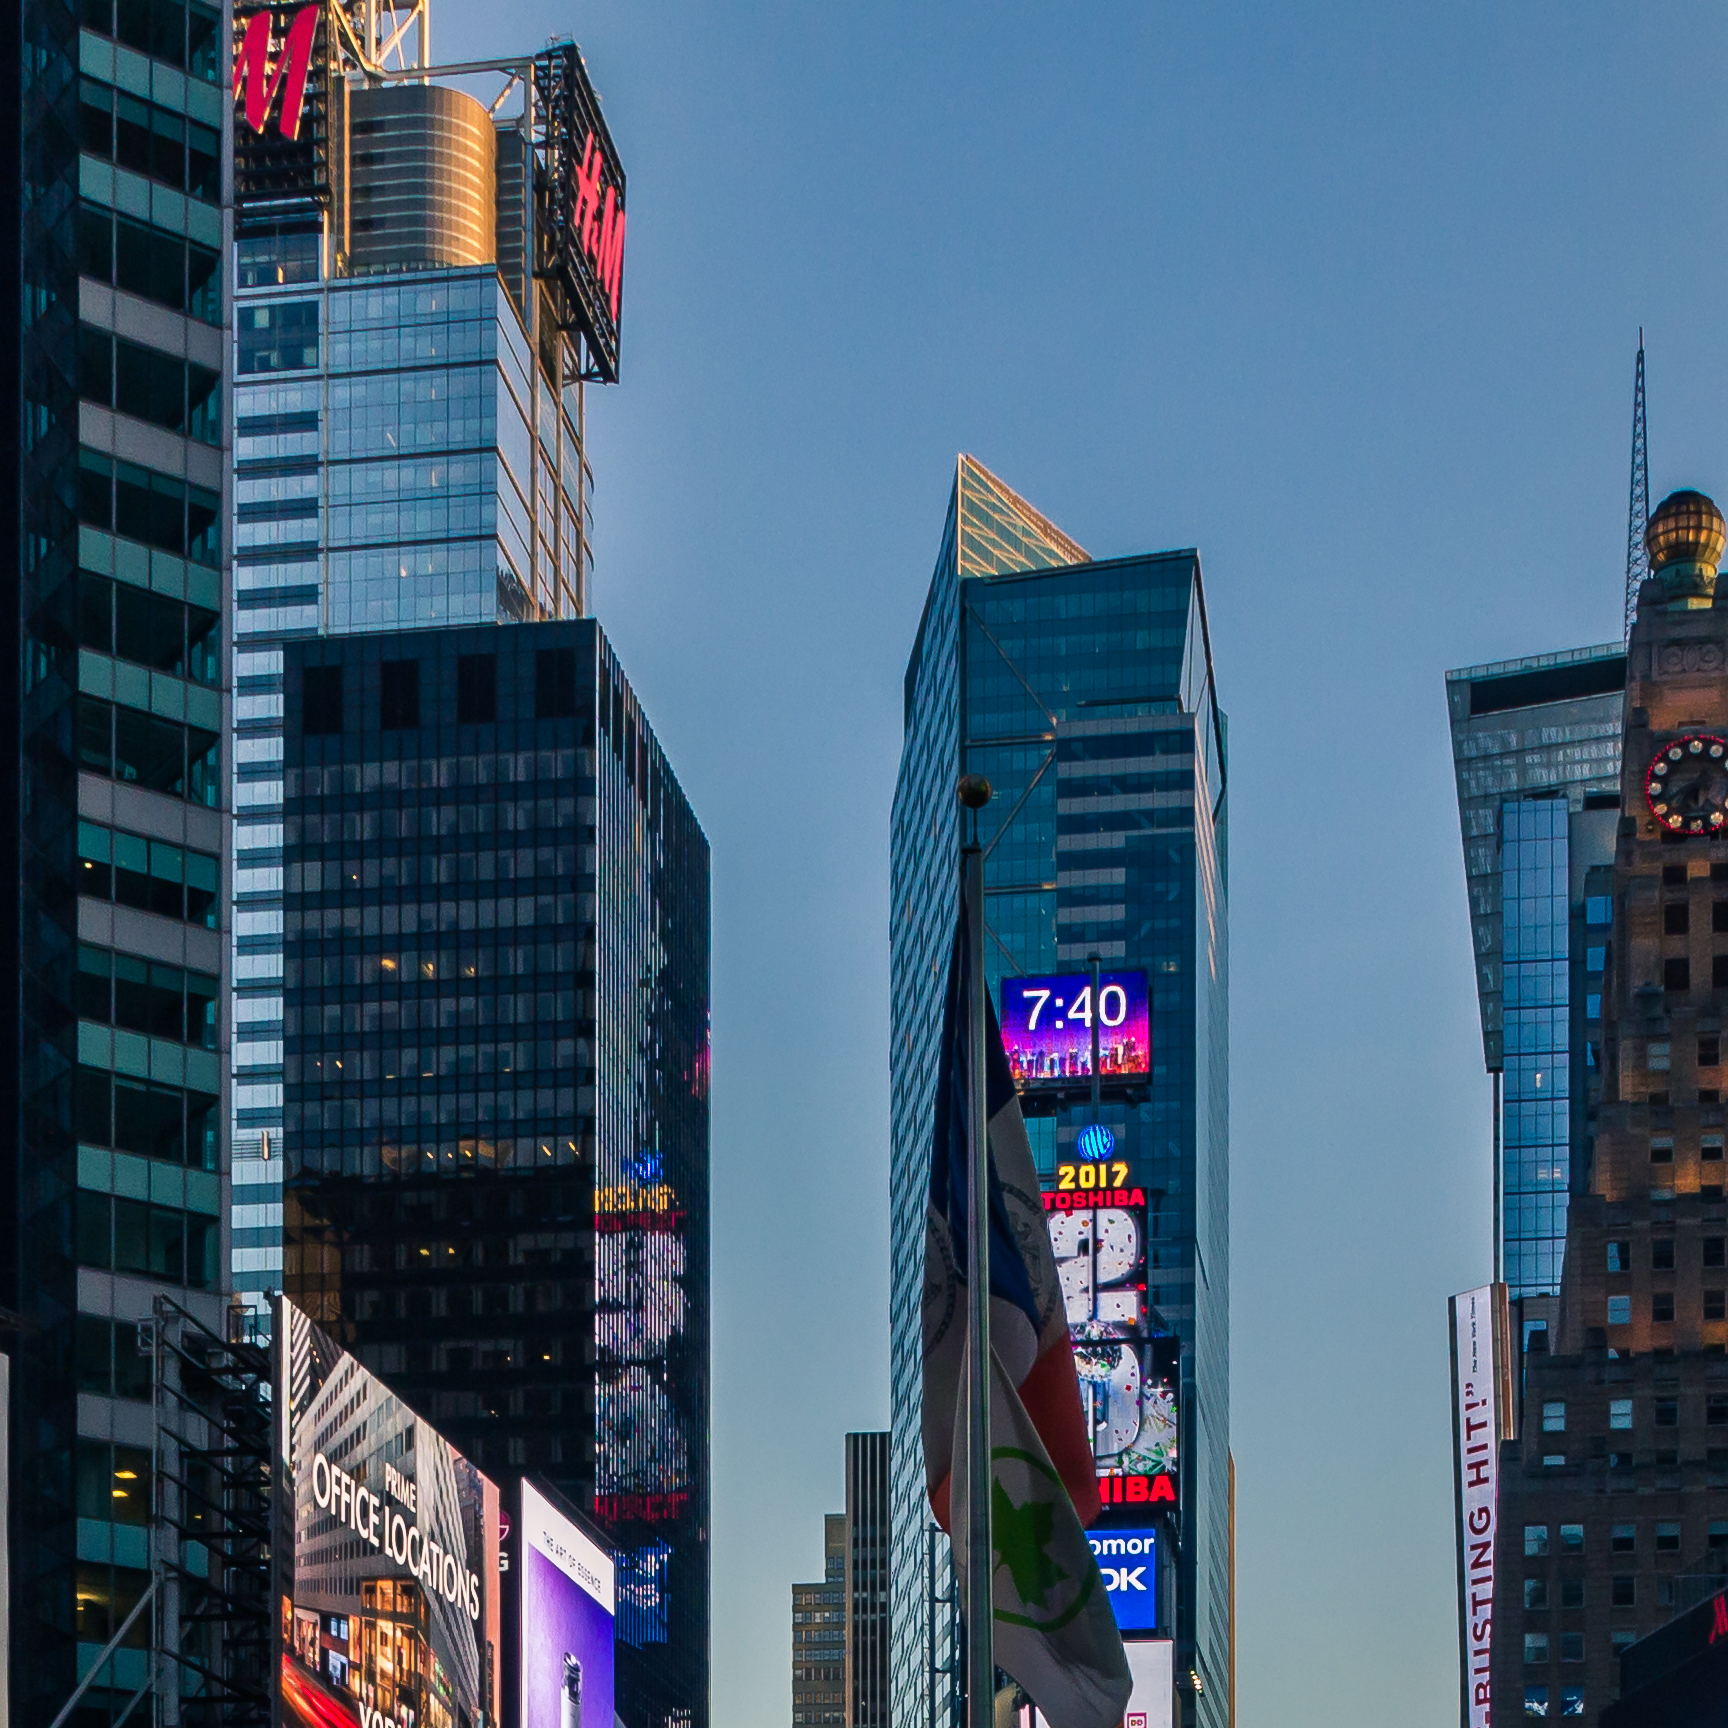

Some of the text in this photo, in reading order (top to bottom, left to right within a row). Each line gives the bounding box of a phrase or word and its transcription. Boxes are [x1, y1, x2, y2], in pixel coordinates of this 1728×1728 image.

[1022, 984, 1127, 1032] 7:40
[1057, 1161, 1130, 1189] 2017
[1041, 1187, 1147, 1210] TOSHIBA
[385, 1463, 417, 1514] PRIME
[313, 1453, 481, 1621] OFFICE LOCATIONS
[556, 1540, 567, 1561] ART
